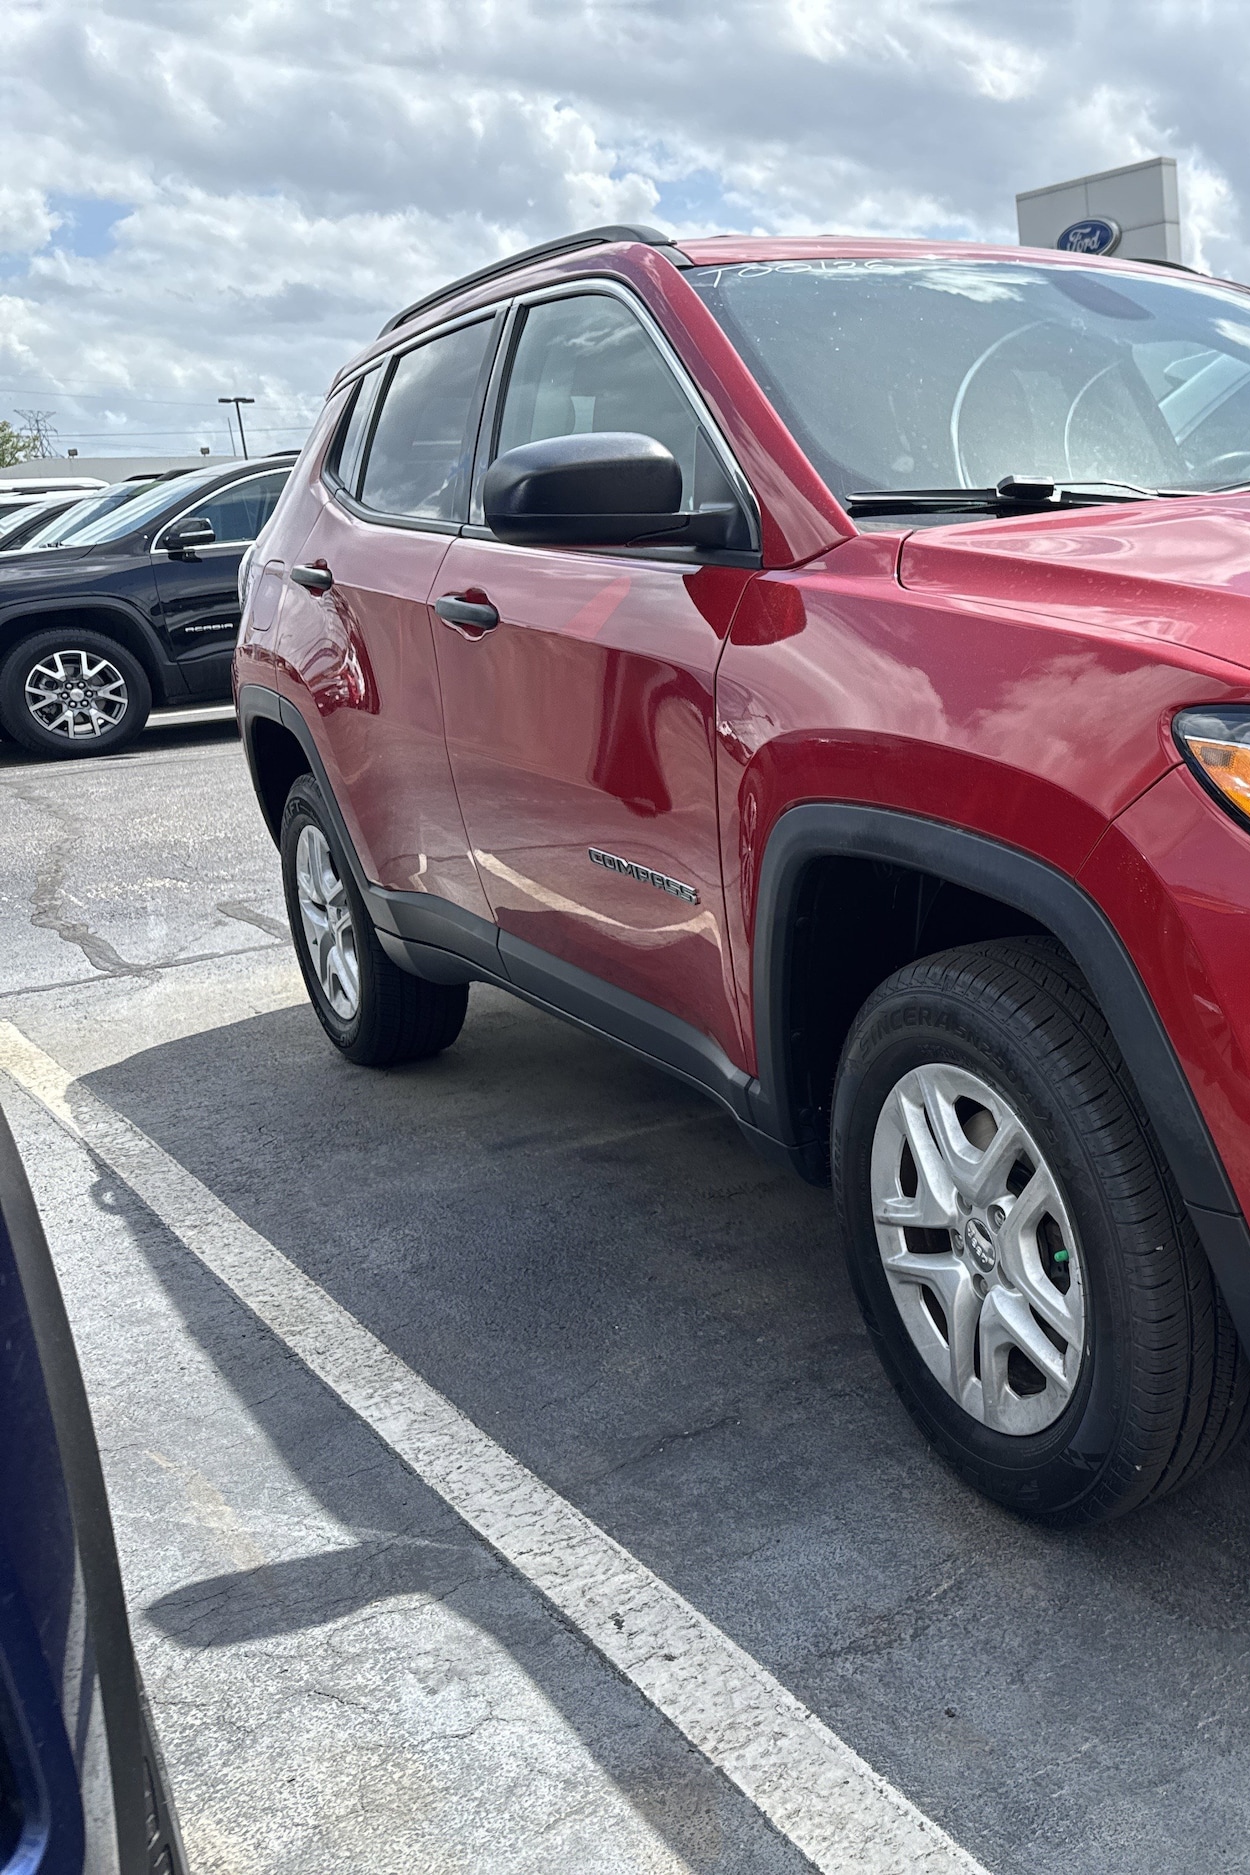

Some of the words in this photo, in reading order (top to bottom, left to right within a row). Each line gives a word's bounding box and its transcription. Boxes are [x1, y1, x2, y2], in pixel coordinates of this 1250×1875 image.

[1066, 226, 1101, 253] Ford
[696, 258, 895, 288] T00126
[588, 846, 701, 905] COMPASS
[859, 1005, 954, 1060] SINCERA
